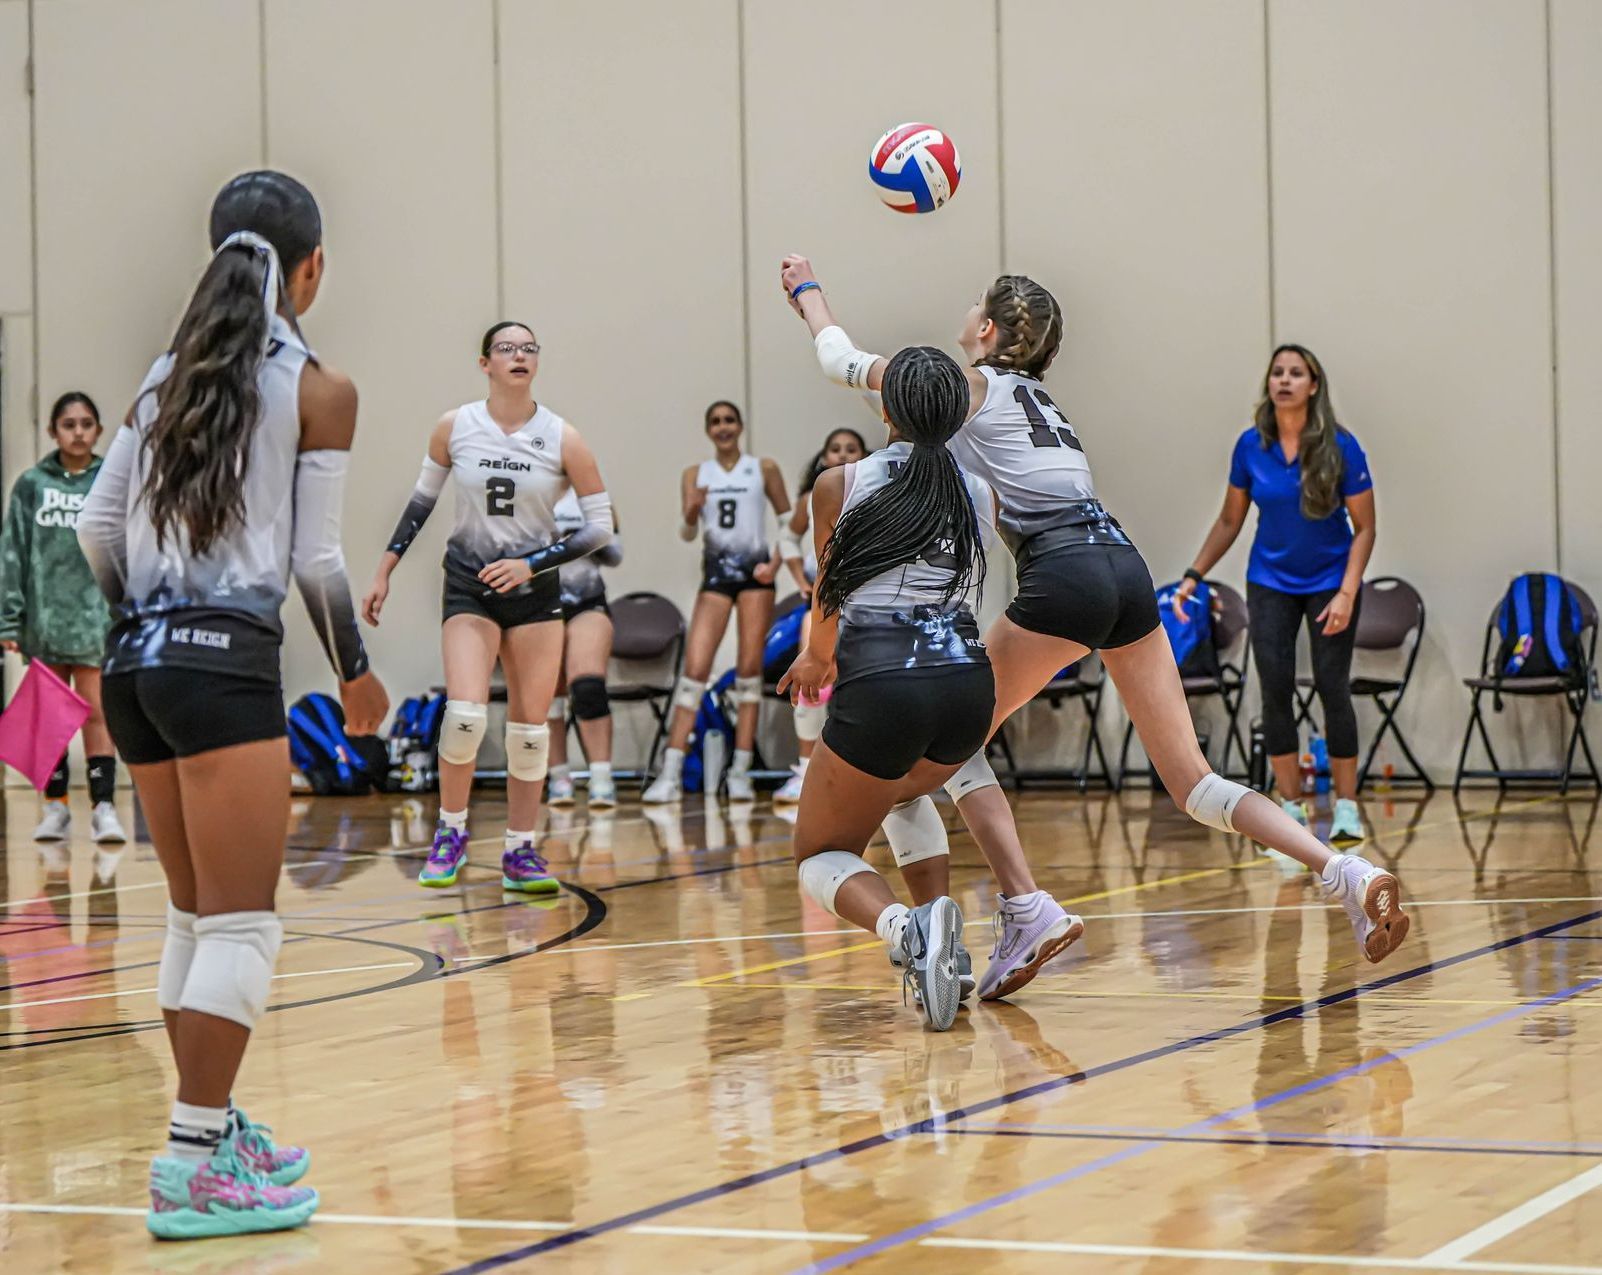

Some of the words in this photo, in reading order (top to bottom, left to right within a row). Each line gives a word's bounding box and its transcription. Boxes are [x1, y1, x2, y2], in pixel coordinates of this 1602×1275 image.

[478, 458, 531, 472] REIGN
[42, 487, 85, 512] BUS
[486, 476, 515, 517] 2
[718, 498, 737, 530] 8
